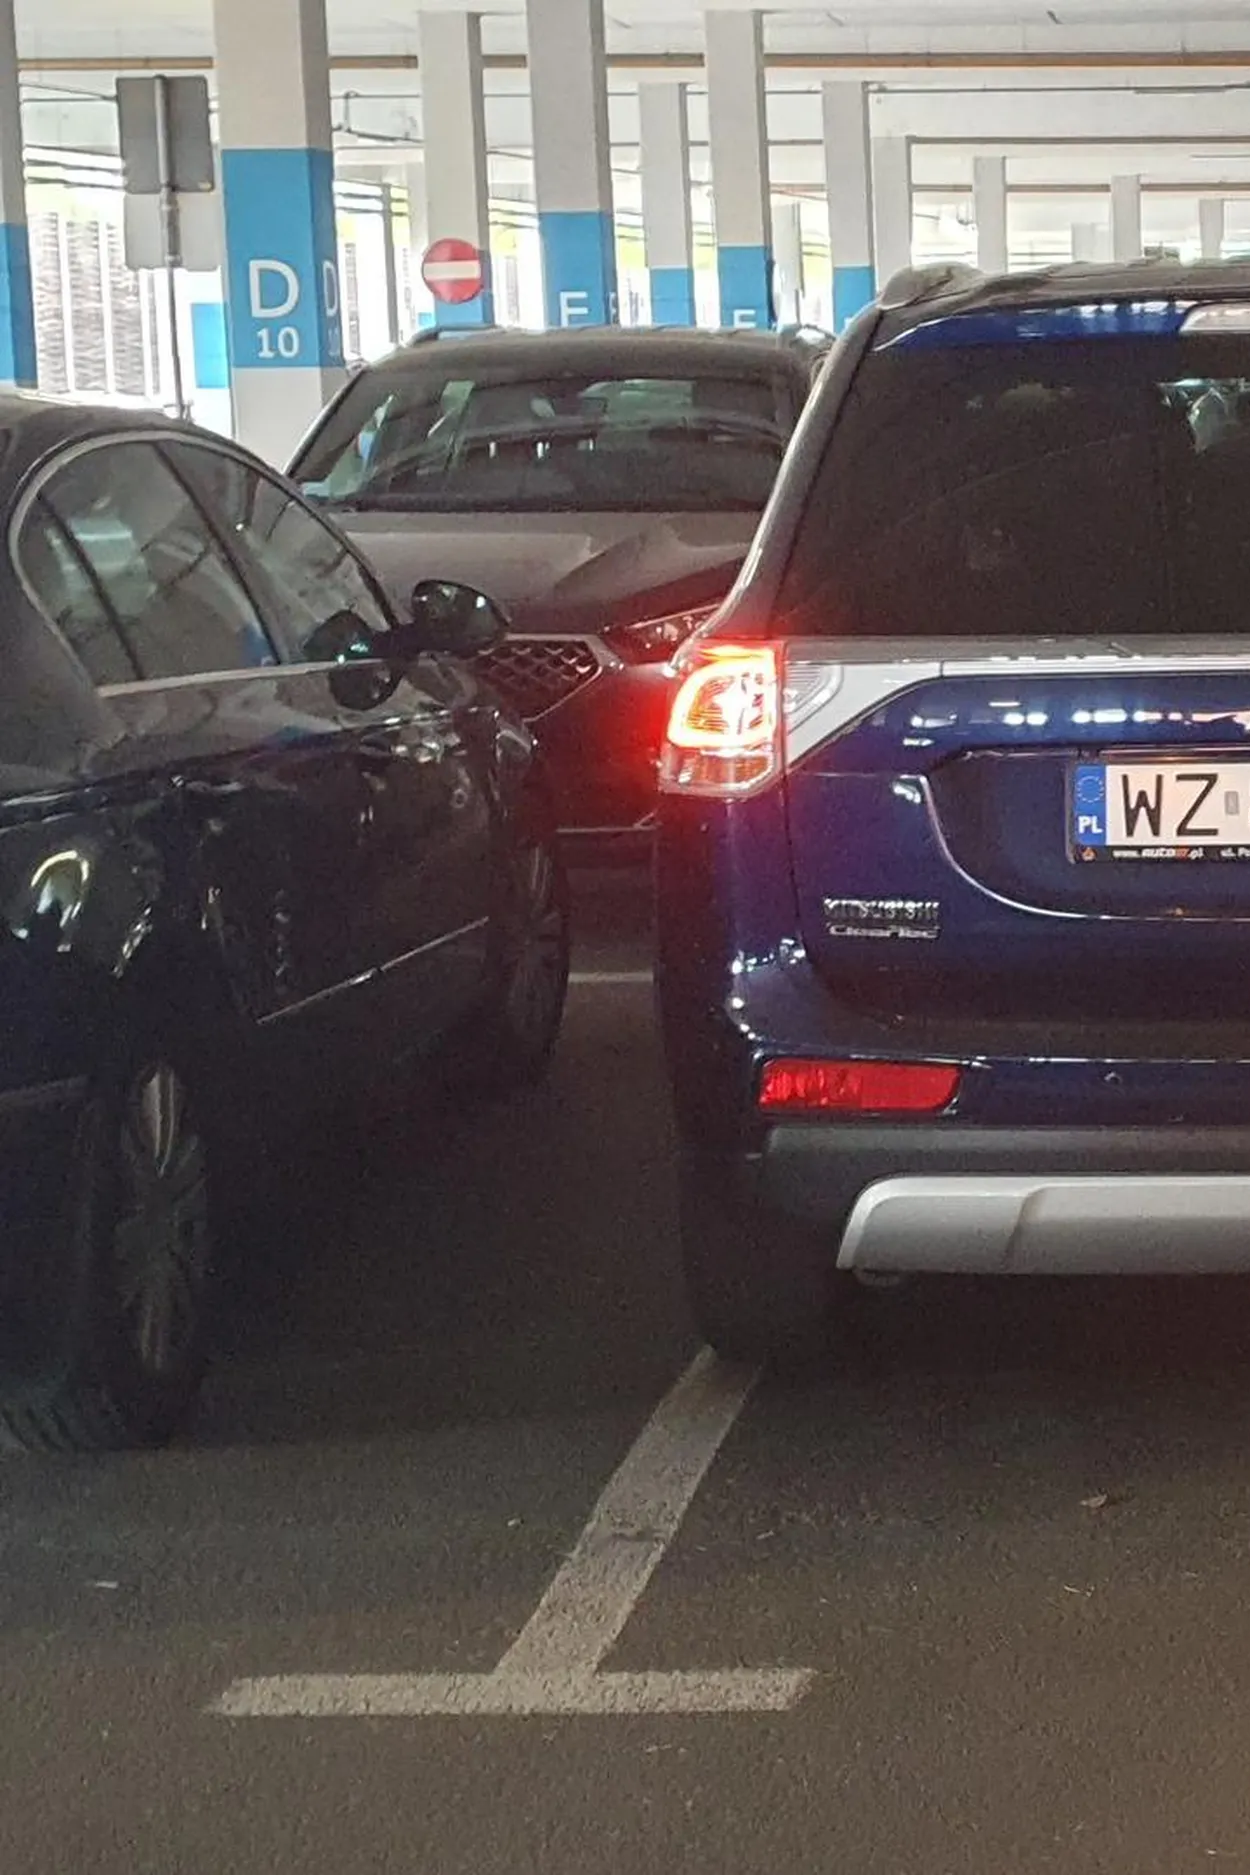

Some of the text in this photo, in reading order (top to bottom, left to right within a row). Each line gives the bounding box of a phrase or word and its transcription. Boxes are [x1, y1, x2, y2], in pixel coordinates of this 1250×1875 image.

[249, 259, 300, 318] D
[257, 326, 300, 359] 10
[1078, 815, 1103, 834] PL
[1121, 773, 1219, 838] WZ
